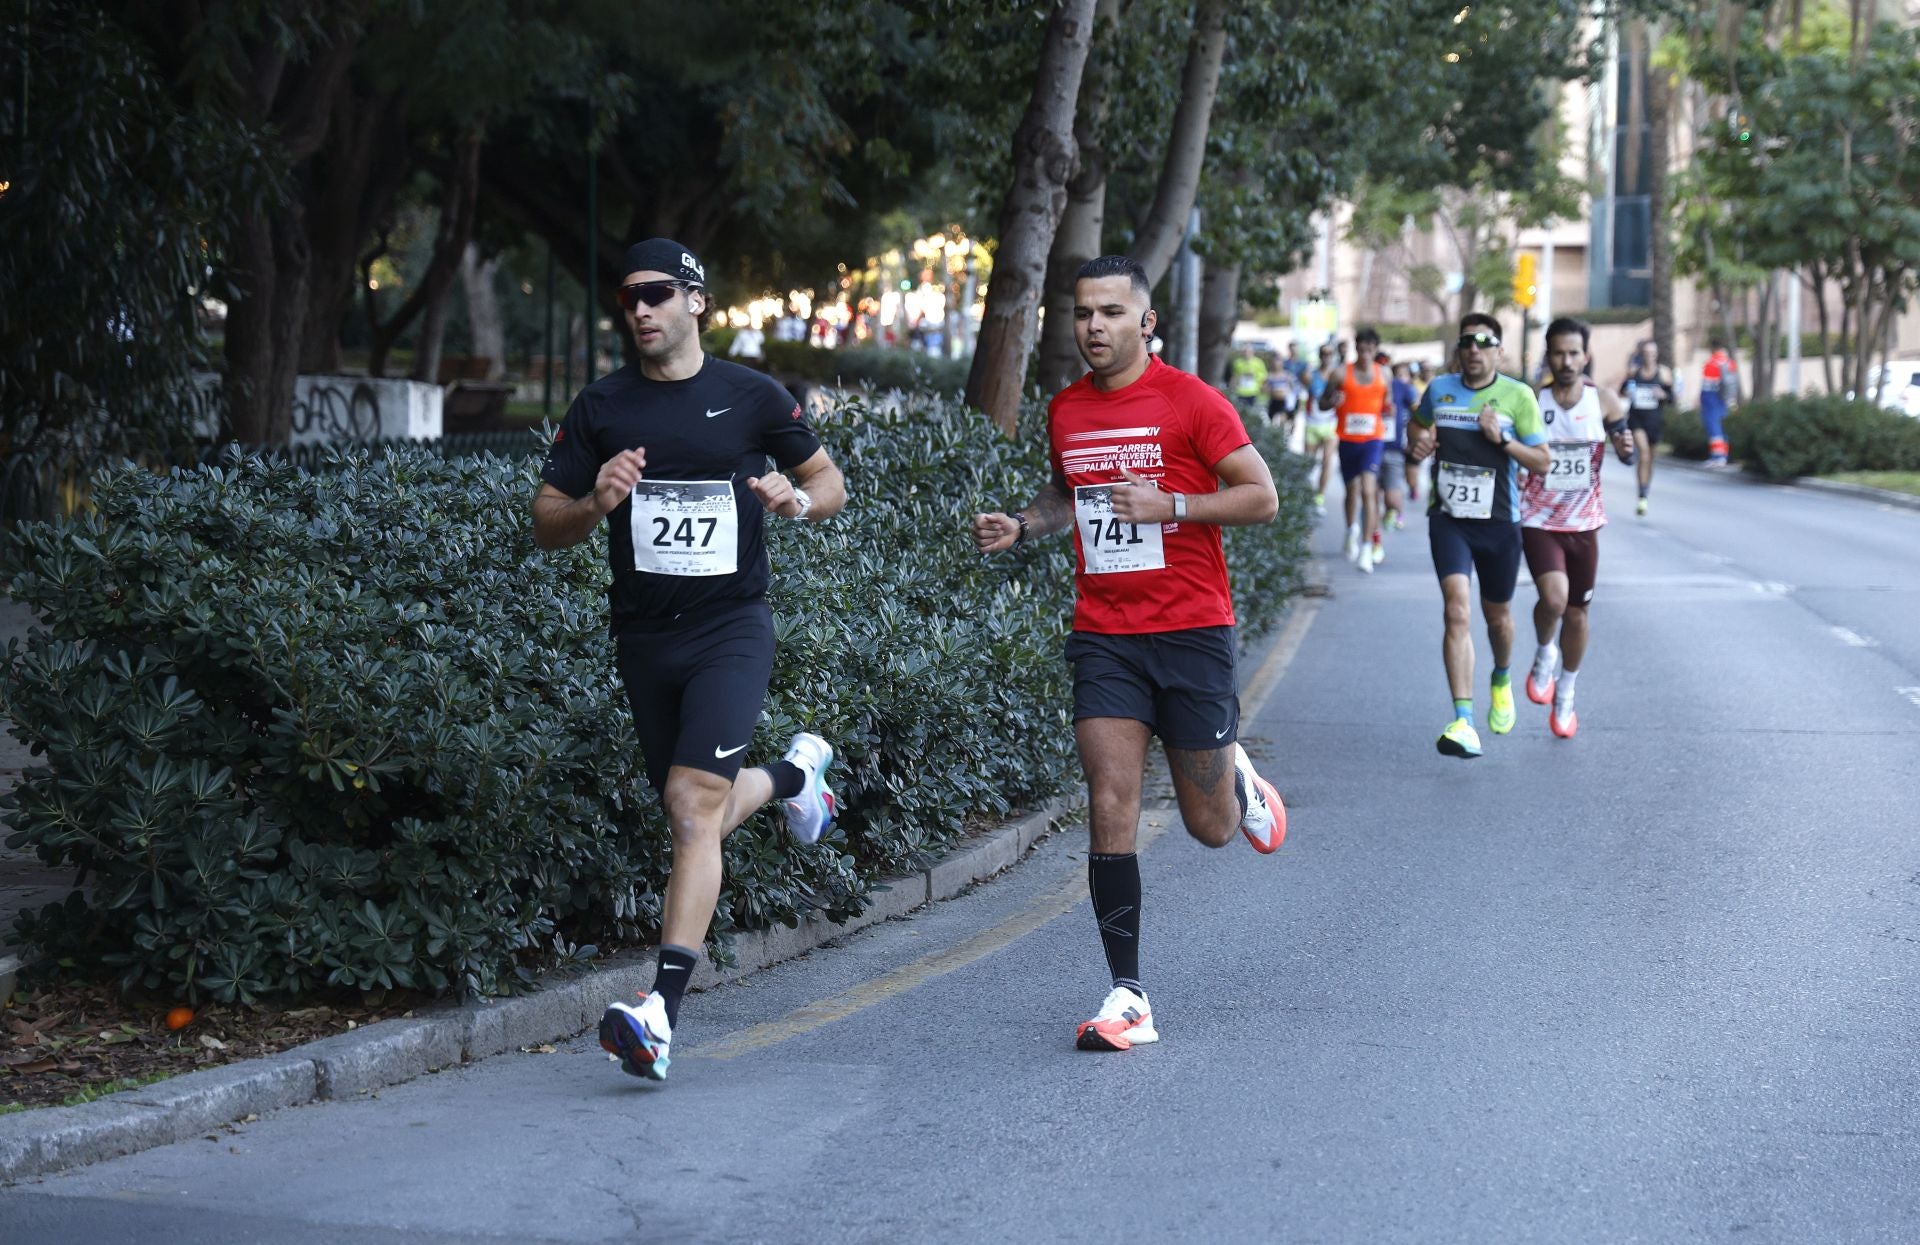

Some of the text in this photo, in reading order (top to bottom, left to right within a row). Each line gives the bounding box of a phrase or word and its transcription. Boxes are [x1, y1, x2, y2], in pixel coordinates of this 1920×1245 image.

[1145, 427, 1161, 436] XIV
[1115, 443, 1162, 453] CARRERA
[1103, 452, 1162, 462] SAN SILVESTRE
[1083, 459, 1164, 472] PALMA PALMILLA
[1550, 459, 1586, 475] 236
[1447, 484, 1481, 503] 731
[652, 516, 718, 547] 247
[1088, 517, 1144, 547] 741
